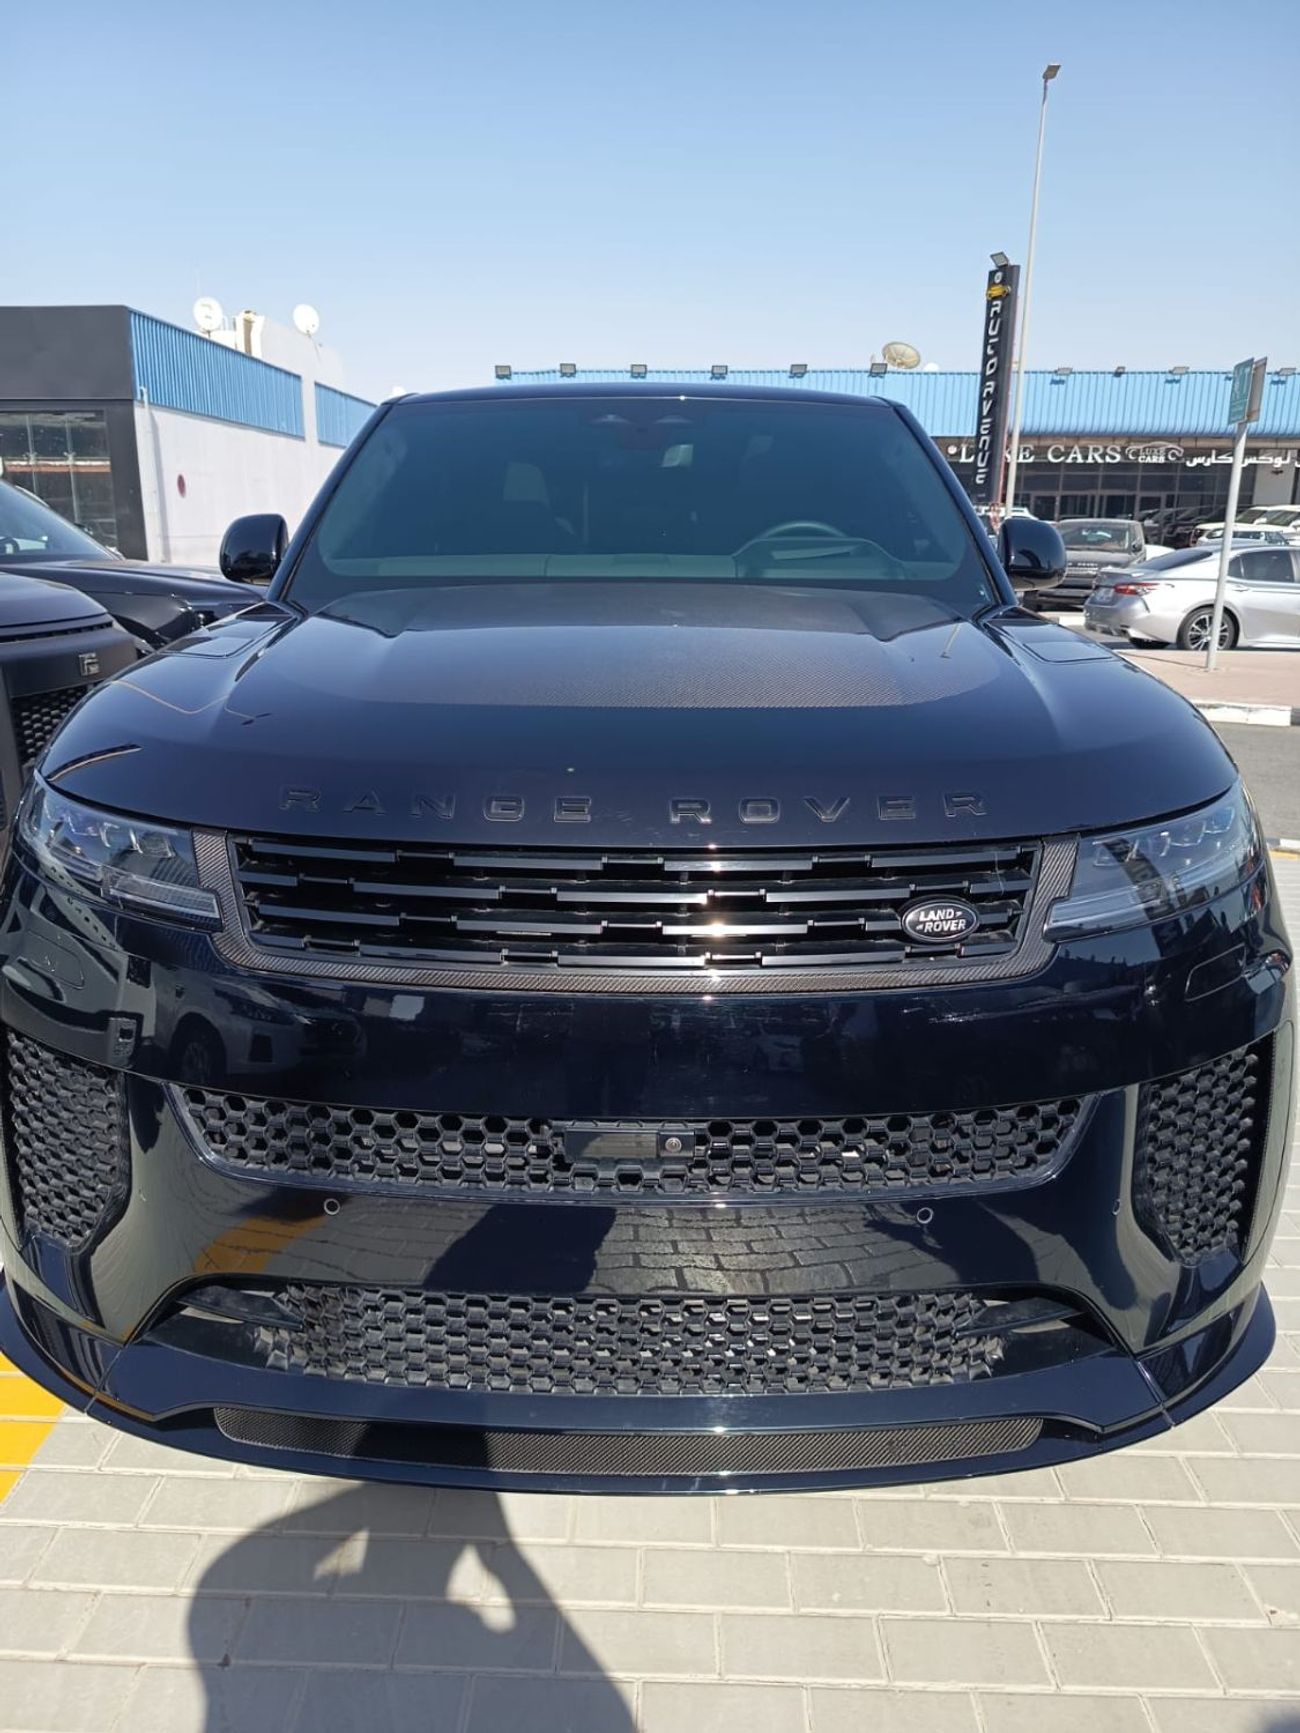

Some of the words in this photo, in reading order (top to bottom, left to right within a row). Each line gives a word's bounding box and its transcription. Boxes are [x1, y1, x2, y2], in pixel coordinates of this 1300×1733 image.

[959, 444, 1035, 463] LE
[1047, 445, 1122, 463] CARS
[280, 785, 592, 823] RANGE
[669, 792, 987, 824] ROVER
[919, 909, 955, 922] LAND
[924, 919, 966, 933] ROVER
